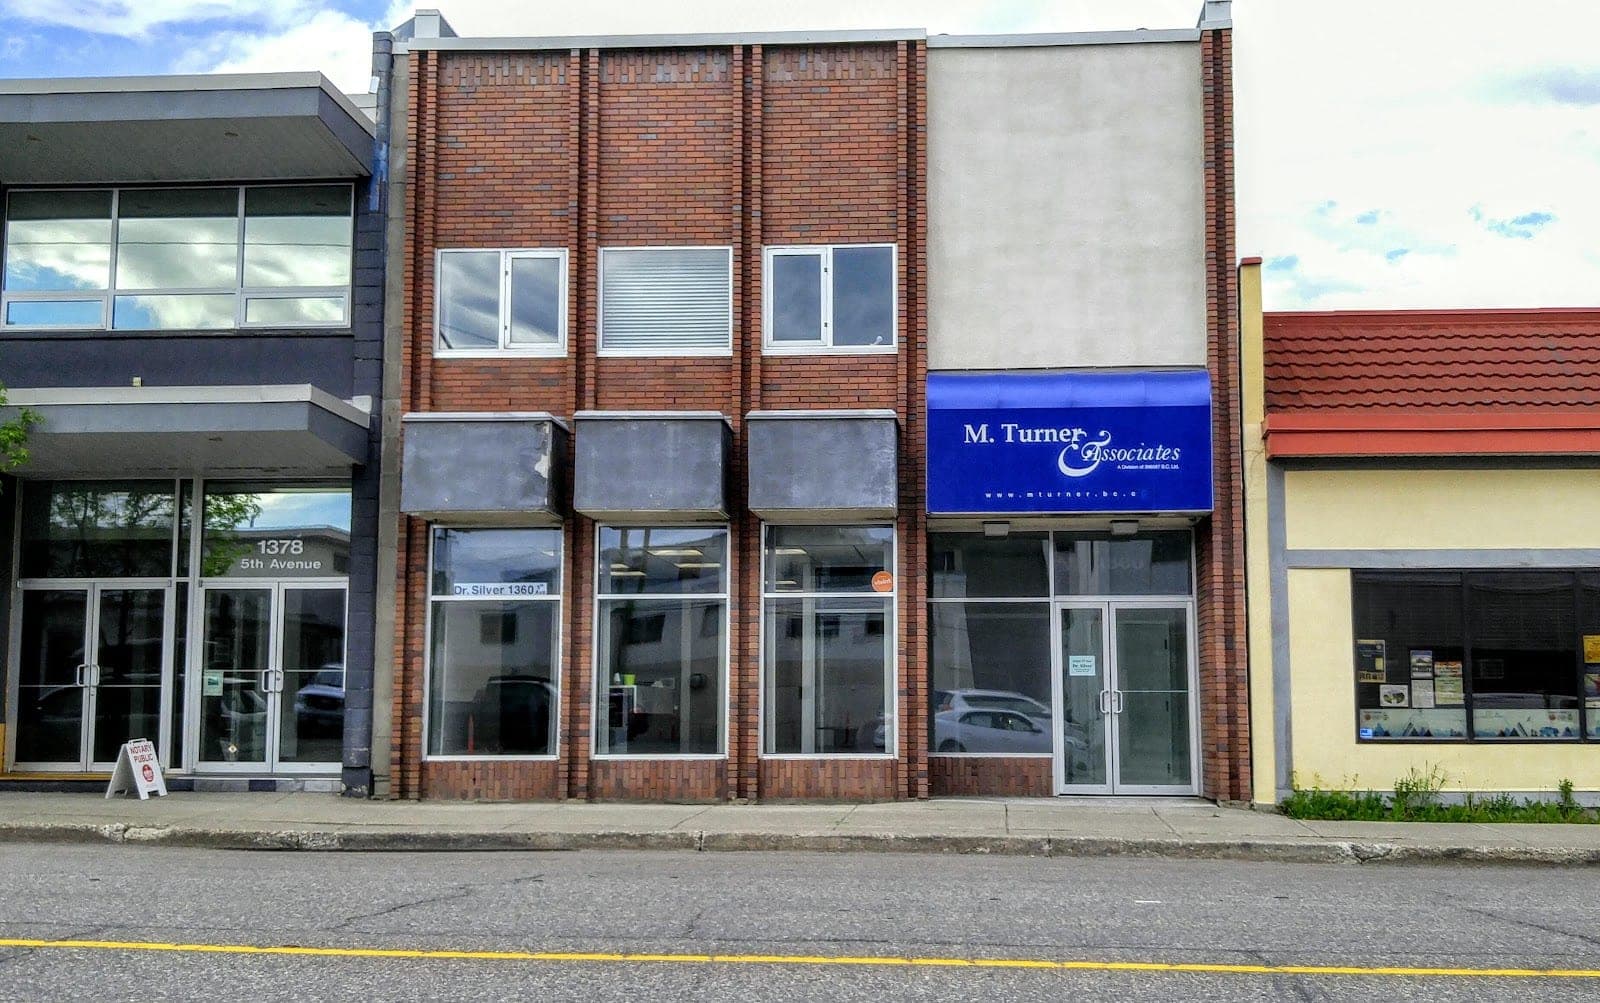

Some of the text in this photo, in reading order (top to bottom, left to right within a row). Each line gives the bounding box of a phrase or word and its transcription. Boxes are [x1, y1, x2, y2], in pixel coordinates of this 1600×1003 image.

[964, 424, 1086, 443] M. Turner
[1082, 442, 1181, 461] Associates
[257, 540, 303, 554] 1378
[241, 559, 321, 569] 5th Avenue
[454, 585, 469, 595] Dr.
[472, 585, 504, 595] Silver
[509, 585, 534, 595] 1360
[130, 744, 152, 754] NOTARY
[133, 754, 153, 763] PUBLIC
